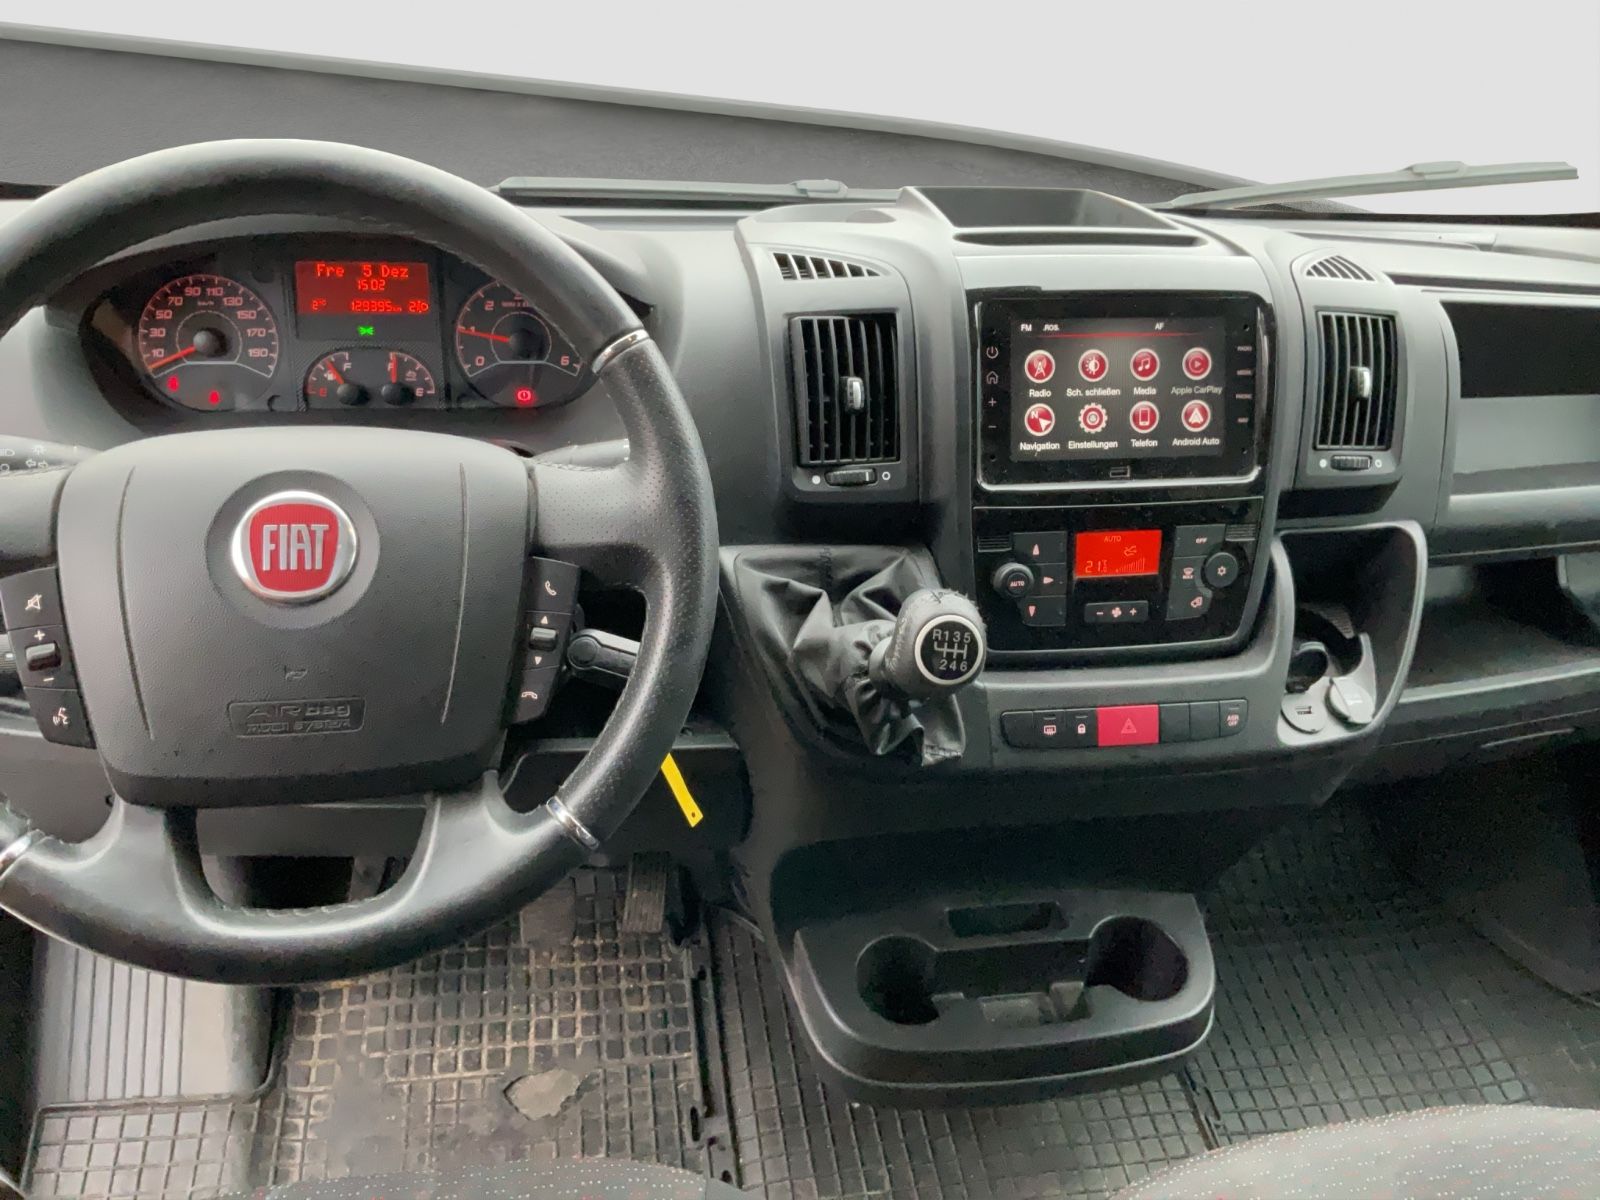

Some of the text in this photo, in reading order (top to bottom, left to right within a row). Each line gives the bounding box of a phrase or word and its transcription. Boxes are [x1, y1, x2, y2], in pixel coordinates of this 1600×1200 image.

[316, 263, 409, 278] Fre 5 Dez
[185, 287, 201, 296] 90
[206, 287, 223, 297] 110
[168, 297, 183, 306] 70
[223, 297, 243, 306] 130
[484, 301, 495, 311] 2
[156, 310, 172, 319] 50
[237, 310, 257, 319] 150
[1020, 323, 1032, 332] FM
[1154, 322, 1165, 330] AF
[149, 328, 166, 337] 30
[246, 328, 266, 337] 170
[151, 349, 165, 357] 10
[248, 349, 268, 357] 190
[475, 356, 485, 366] 0
[560, 356, 570, 366] 6
[343, 362, 352, 371] F
[415, 387, 424, 397] E
[1029, 388, 1052, 397] Radio
[1066, 387, 1121, 397] Sch. schließen
[1133, 386, 1157, 395] Media
[1171, 385, 1223, 396] Apple CarPlay
[1067, 440, 1119, 450] Einstellungen
[1130, 438, 1158, 448] Telefon
[1172, 436, 1220, 447] Android Auto
[1019, 441, 1060, 452] Navigation
[1103, 535, 1122, 543] AUTO
[262, 523, 330, 572] FIAT
[932, 628, 971, 643] R 1 3 5
[938, 659, 968, 672] 2 4 6
